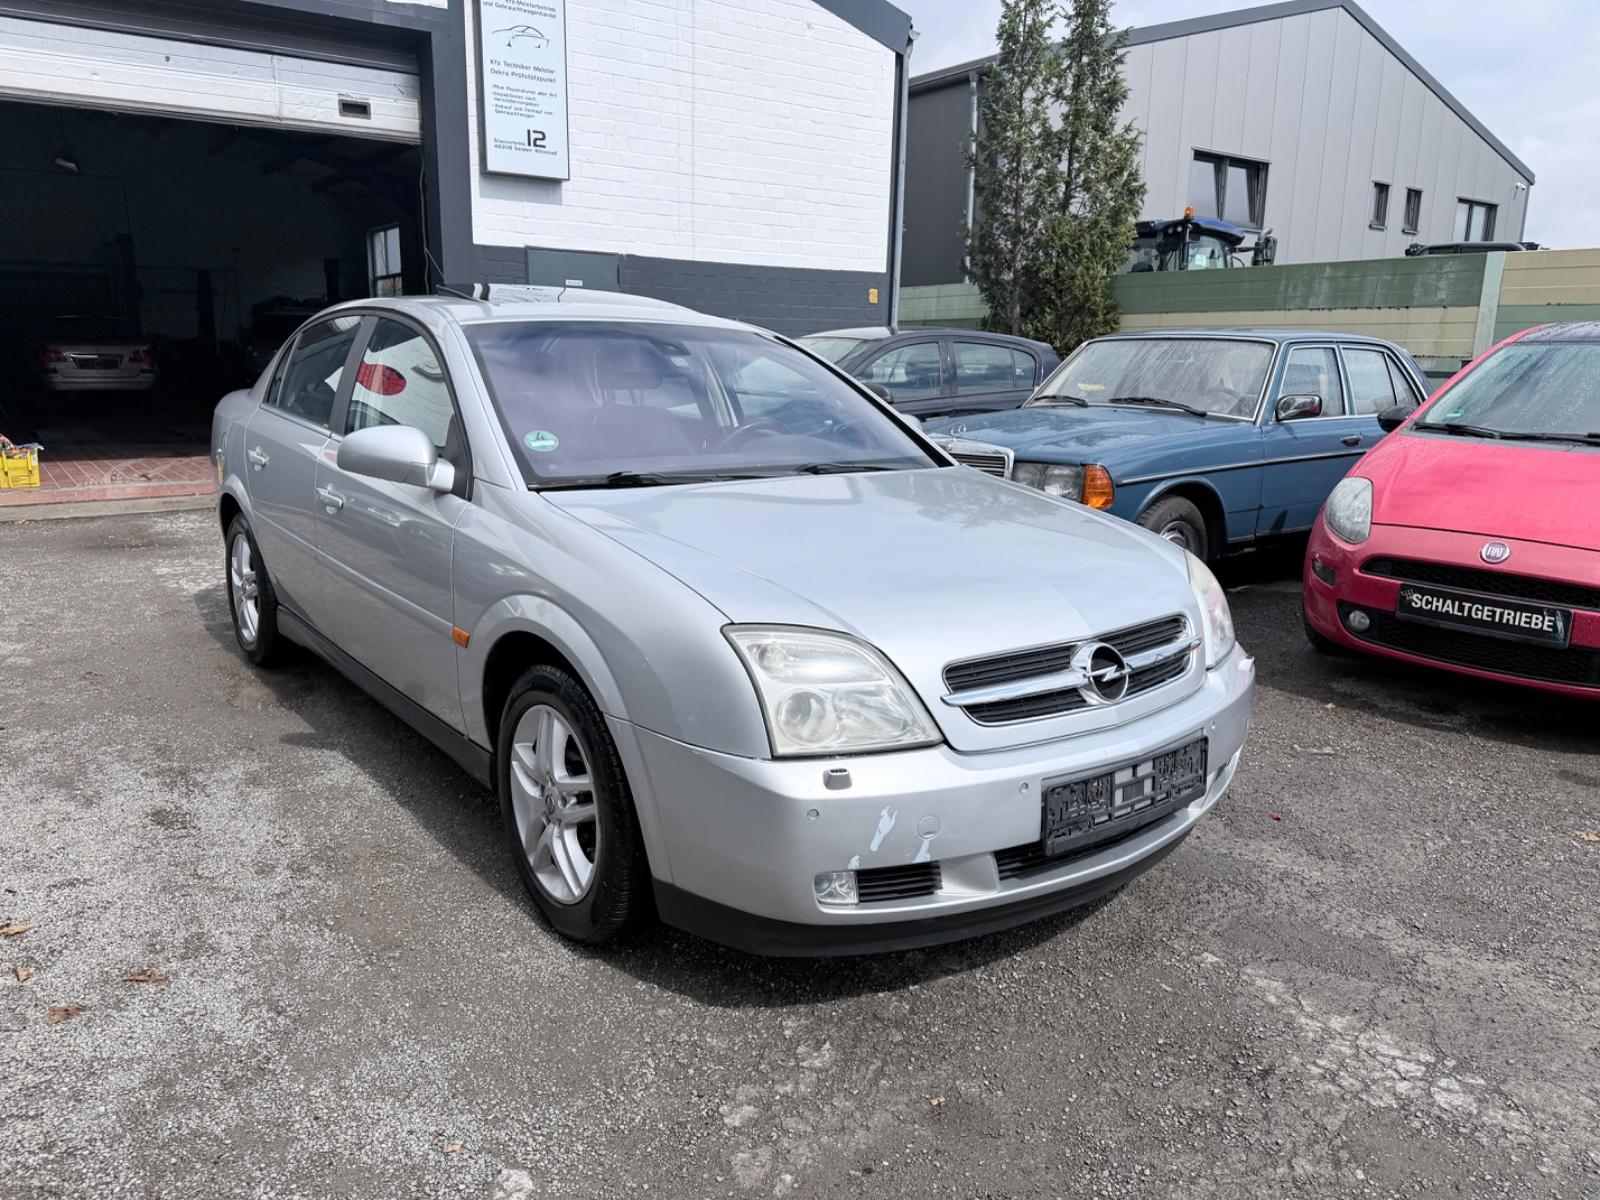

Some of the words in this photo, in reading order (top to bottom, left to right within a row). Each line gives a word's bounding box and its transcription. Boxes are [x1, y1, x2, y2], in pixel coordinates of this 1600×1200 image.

[495, 2, 557, 19] Gebrauchtwagenhandel
[503, 61, 531, 70] Techniker
[533, 66, 555, 74] Meister
[490, 68, 509, 76] Dekra
[511, 71, 556, 83] Prüfstützpunkt
[506, 86, 536, 94] Reparaturen
[494, 109, 535, 119] Gebrauchtwagen
[527, 129, 546, 148] 12
[1486, 545, 1505, 558] FIAT
[1411, 593, 1555, 632] SCHALTGETRIEBE
